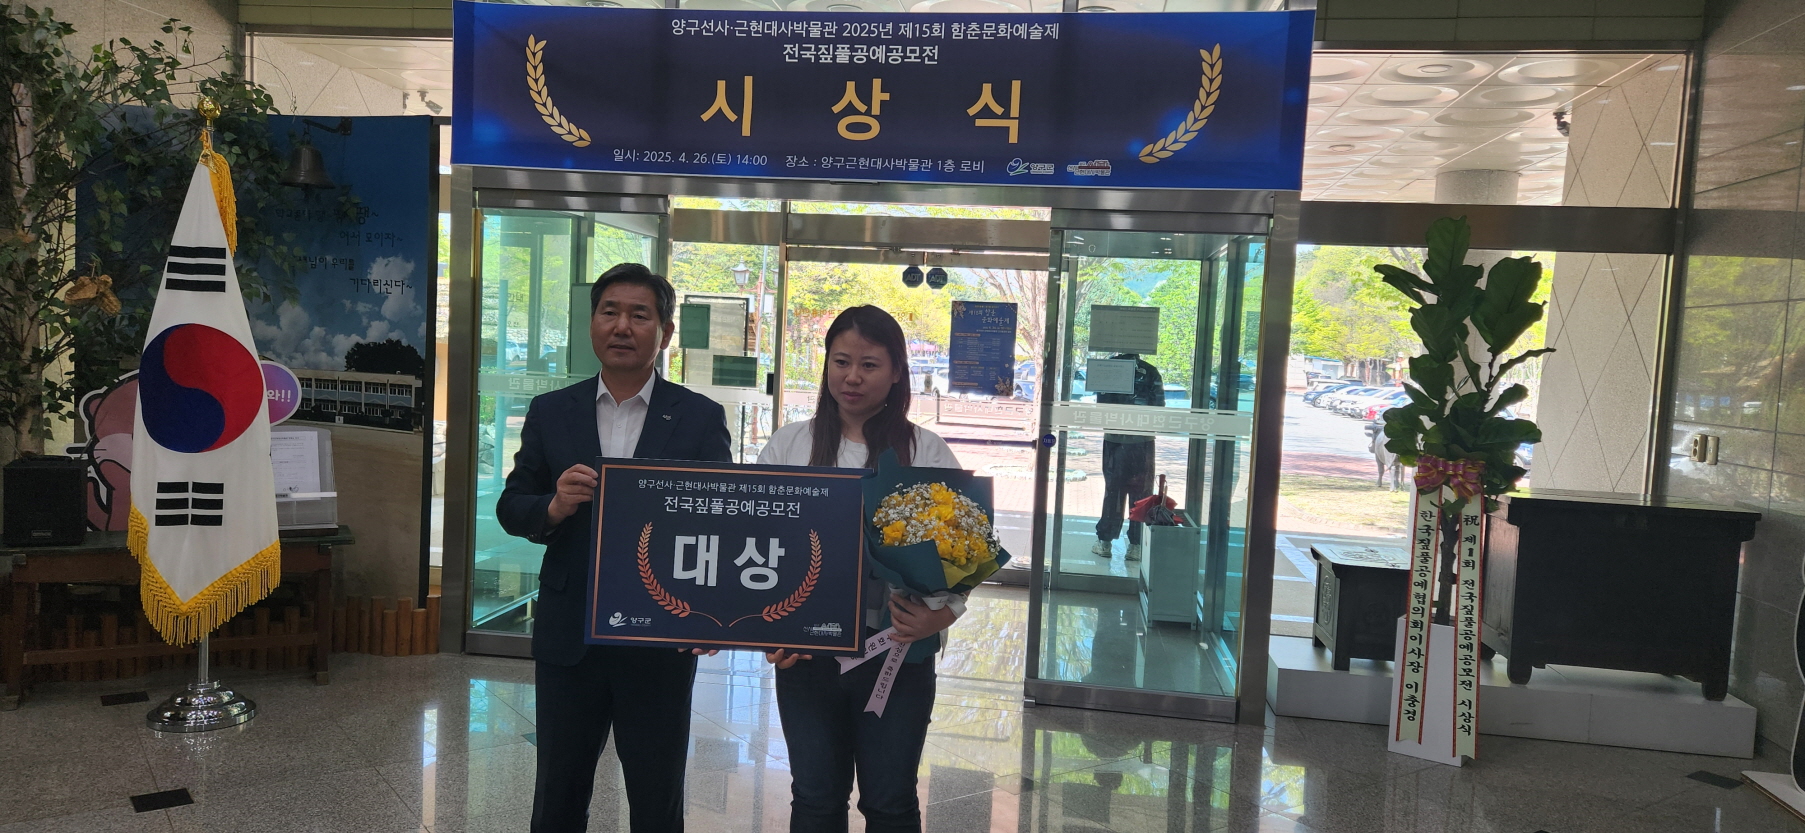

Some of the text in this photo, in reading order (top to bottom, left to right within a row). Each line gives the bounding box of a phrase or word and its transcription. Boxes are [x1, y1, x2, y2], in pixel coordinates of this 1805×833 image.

[671, 18, 1060, 40] 양구선사·근현대사박물관 2025년 제15회 함춘문화예술제
[783, 43, 939, 65] 전국짚풀공예공모전
[613, 149, 768, 166] 일시: 2025. 4. 26.(토) 14:00
[785, 155, 809, 168] 장소
[821, 156, 933, 172] 양구근현대사박물관
[937, 159, 956, 173] 1층
[959, 160, 985, 173] 로비
[340, 230, 361, 247] 어서
[905, 273, 921, 282] ADT
[929, 275, 945, 283] ADT
[638, 479, 829, 498] 양구선사·근현대사박물관 제15회 함춘문화예술제
[664, 496, 800, 519] 전국짚풀공예공모전
[1462, 514, 1480, 526] 祝
[1457, 579, 1478, 691] 전국짚풀공예공모전
[1457, 698, 1475, 736] 시상식
